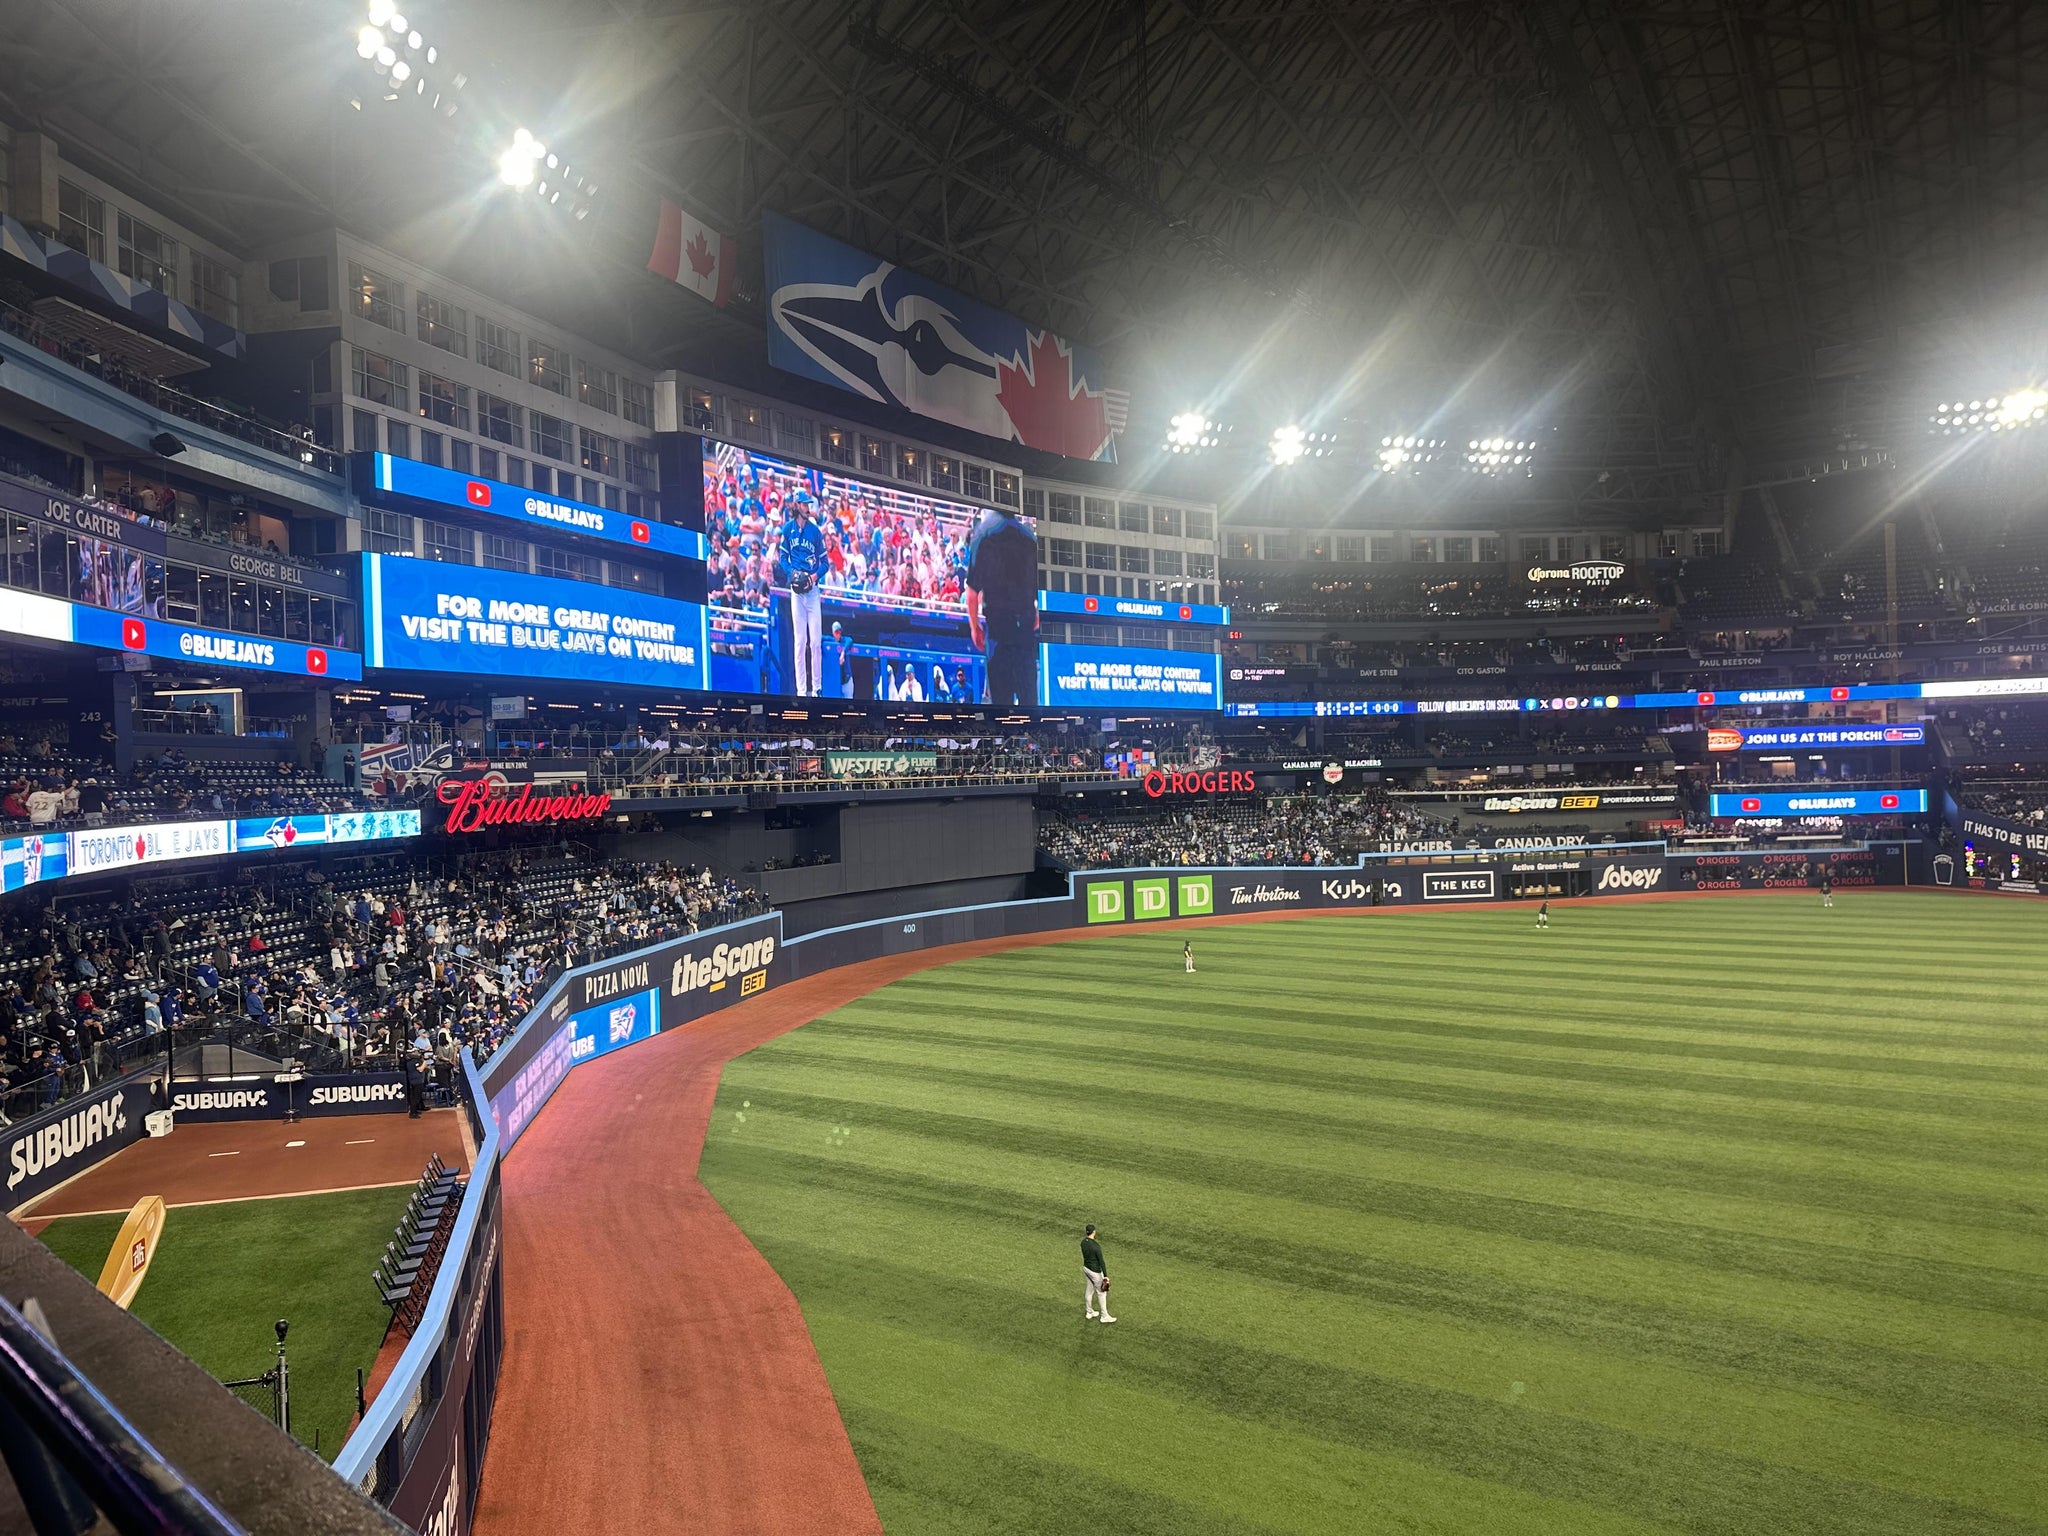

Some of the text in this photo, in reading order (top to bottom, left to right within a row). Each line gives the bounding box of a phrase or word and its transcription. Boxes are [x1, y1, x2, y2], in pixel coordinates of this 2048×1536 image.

[44, 499, 121, 540] JOE CARTER
[525, 498, 604, 531] @BLUEJAYS
[230, 553, 303, 584] GEORGE BELL
[1528, 566, 1624, 582] Corona ROOFTOP
[1116, 602, 1163, 616] @BLUEJAYS
[1982, 604, 2016, 613] JACKIE
[437, 594, 675, 642] FOR MORE GREAT CONTENT
[180, 632, 275, 665] @BLUEJAYS
[401, 615, 695, 666] VISIT THE BLUE JAYS ON YOUTUBE
[1700, 657, 1761, 667] PAUL BEESTON
[1833, 651, 1903, 661] ROY HALLADAY
[1074, 663, 1201, 680] FOR MORE GREAT CONTENT
[1360, 669, 1377, 677] DAVE
[1477, 667, 1506, 675] GASTON
[1591, 663, 1622, 671] GILLICK
[1057, 676, 1213, 695] VISIT THE BLUE JAYS ON YOUTUBE
[1739, 691, 1805, 702] @BLUEJAYS
[1417, 699, 1520, 713] FOLLOW @BLUEJAYS ON SOCIAL
[80, 712, 101, 722] 243
[1747, 733, 1777, 745] JOIN
[1781, 733, 1798, 743] US
[1800, 733, 1815, 742] AT
[1816, 732, 1838, 743] THE
[1840, 730, 1882, 742] PORCH!
[829, 757, 937, 775] WESTJET FLIGHT
[1283, 760, 1322, 769] CANADA DRY
[1172, 770, 1256, 794] ROGERS
[436, 779, 611, 834] Budweiser
[1484, 796, 1558, 811] theScore
[1562, 796, 1597, 808] BET
[1788, 798, 1856, 809] @BLUEJAYS
[1964, 820, 1973, 832] IT
[1974, 822, 1993, 837] HAS
[1994, 828, 2008, 841] TO
[2009, 832, 2022, 845] BE
[81, 828, 219, 867] TORONTO BLE JAYS
[1495, 837, 1554, 850] CANADA
[1706, 856, 1740, 864] ROGERS
[1773, 854, 1807, 862] ROGERS
[1840, 853, 1874, 861] ROGERS
[1512, 861, 1581, 871] Active Green+Ross
[1432, 879, 1487, 891] THE KEG
[1598, 864, 1662, 890] Sobeys
[1774, 879, 1808, 887] ROGERS
[1841, 877, 1875, 885] ROGERS
[1181, 883, 1209, 907] TD
[1230, 884, 1301, 904] Tim Hortons
[1321, 879, 1402, 899] Kubta
[1091, 889, 1121, 914] TD
[1136, 885, 1166, 911] TD
[903, 924, 916, 933] 400
[671, 936, 774, 997] theScore
[585, 961, 649, 1003] PIZZA NOVA
[743, 971, 765, 994] BET
[170, 1089, 267, 1112] SUBWAY
[309, 1082, 404, 1107] SUBWAY
[6, 1090, 125, 1191] SUBWAY
